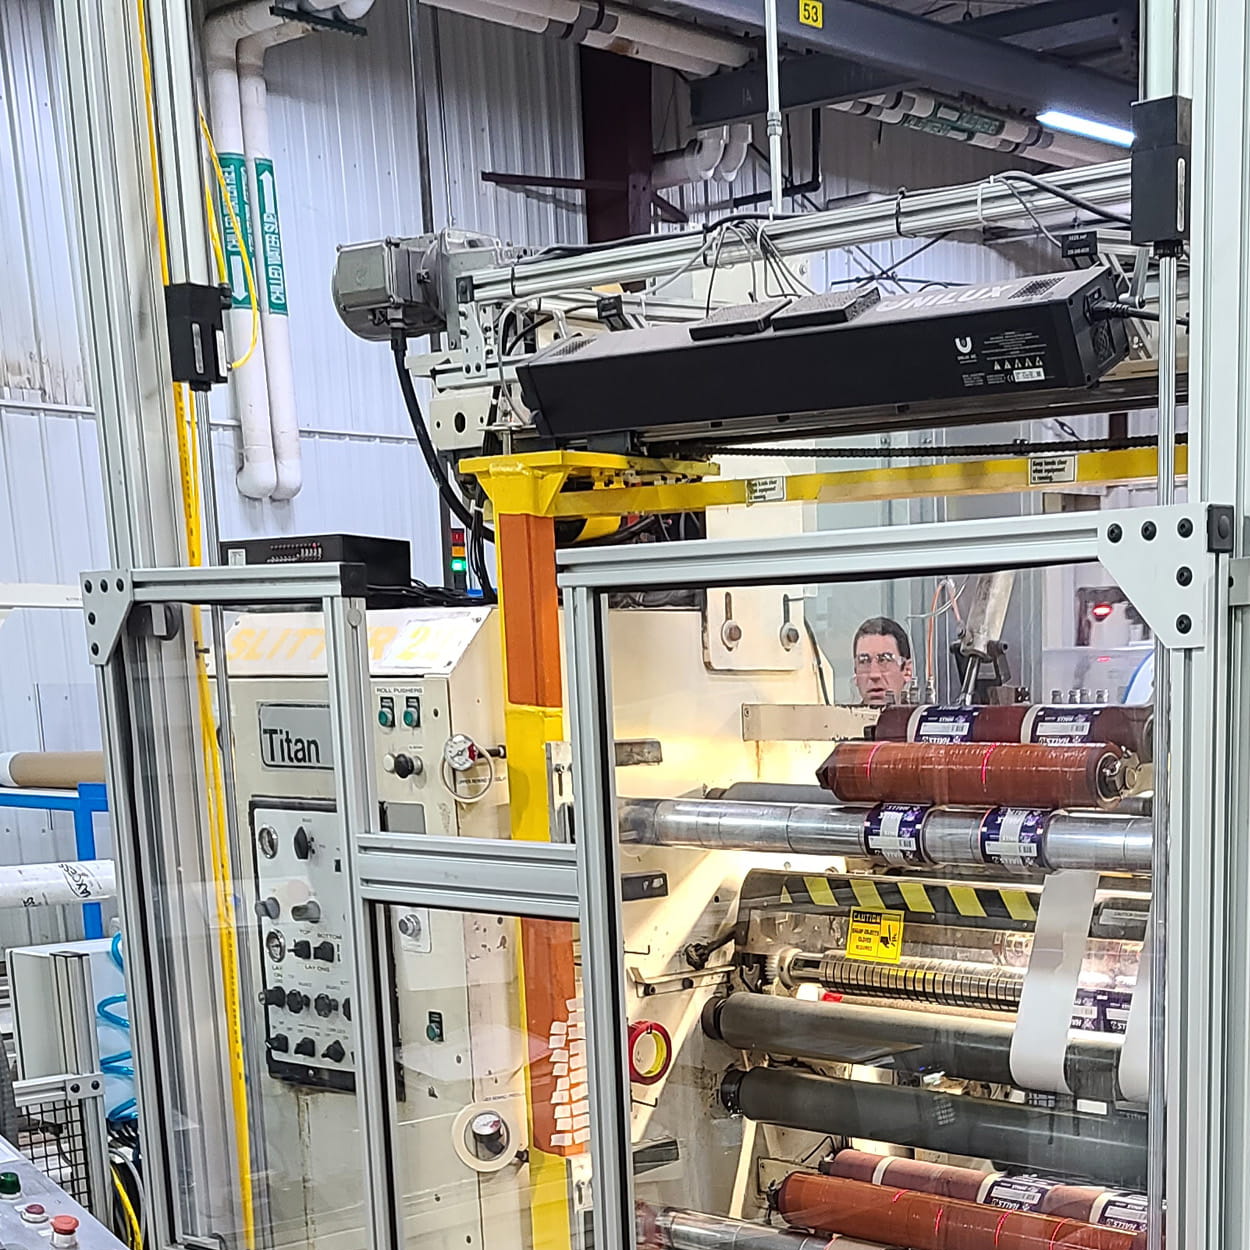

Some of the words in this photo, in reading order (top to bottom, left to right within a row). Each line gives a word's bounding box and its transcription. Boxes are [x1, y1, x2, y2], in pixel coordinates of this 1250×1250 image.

[803, 3, 819, 23] 53
[265, 233, 282, 266] WATER
[268, 266, 286, 304] CHILLED
[229, 627, 398, 661] SLITTR
[262, 728, 321, 764] Titan
[853, 912, 881, 923] CAUTION
[1113, 1221, 1138, 1231] HALLS
